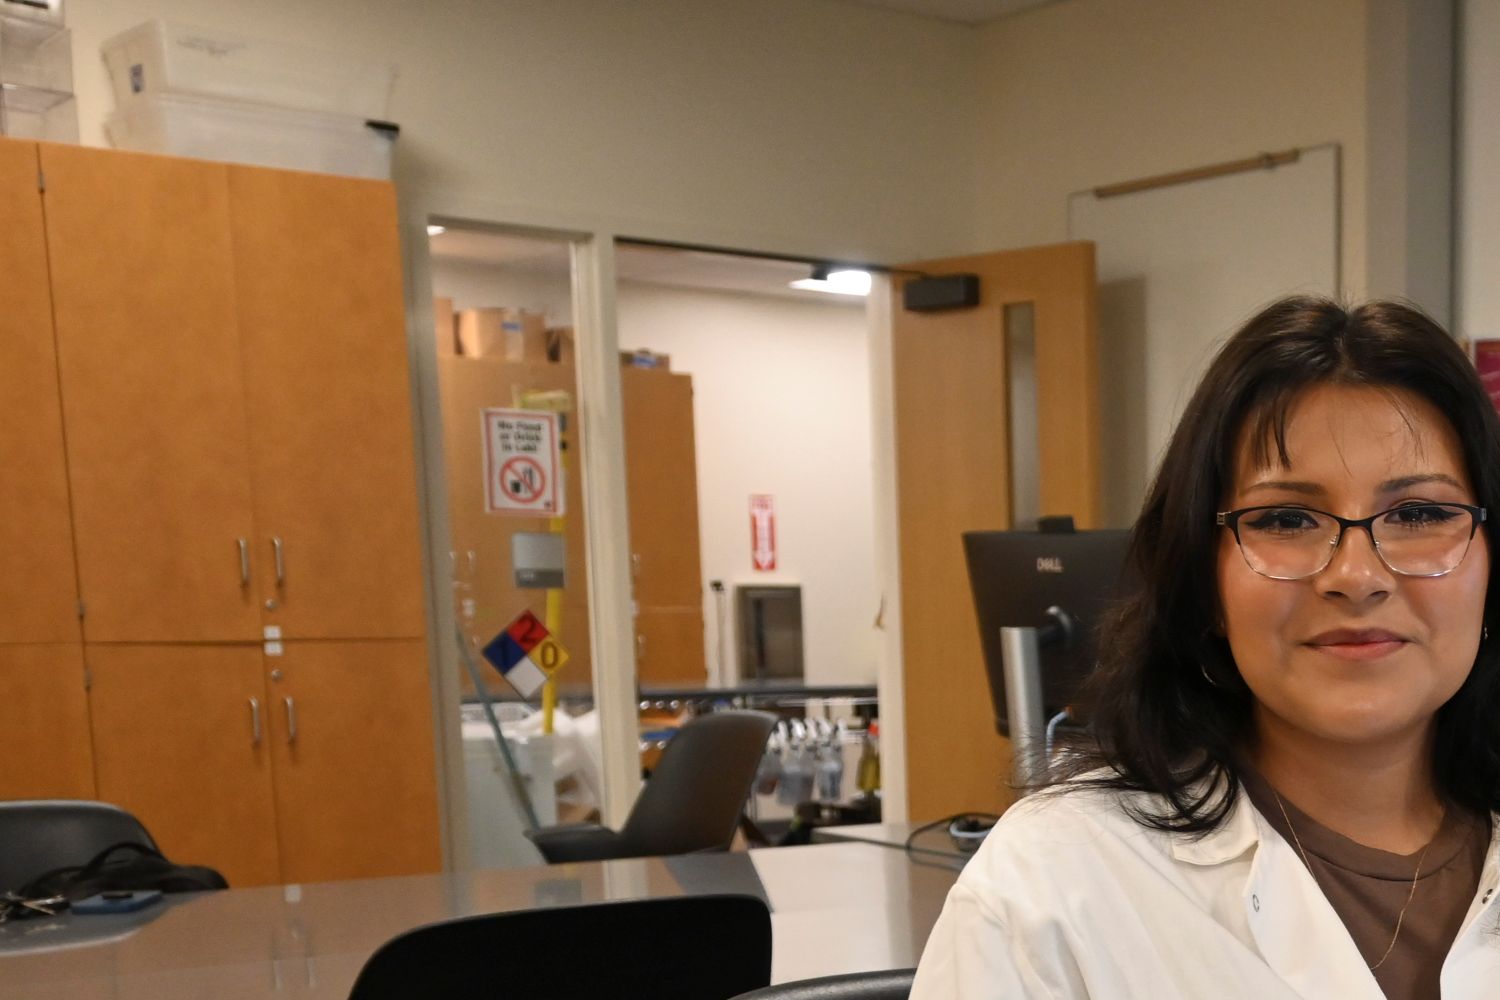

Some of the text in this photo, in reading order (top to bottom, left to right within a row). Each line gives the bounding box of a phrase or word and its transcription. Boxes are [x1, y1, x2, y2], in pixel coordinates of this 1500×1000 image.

[1036, 557, 1063, 573] DELL
[520, 618, 537, 642] 2
[541, 641, 559, 669] 0
